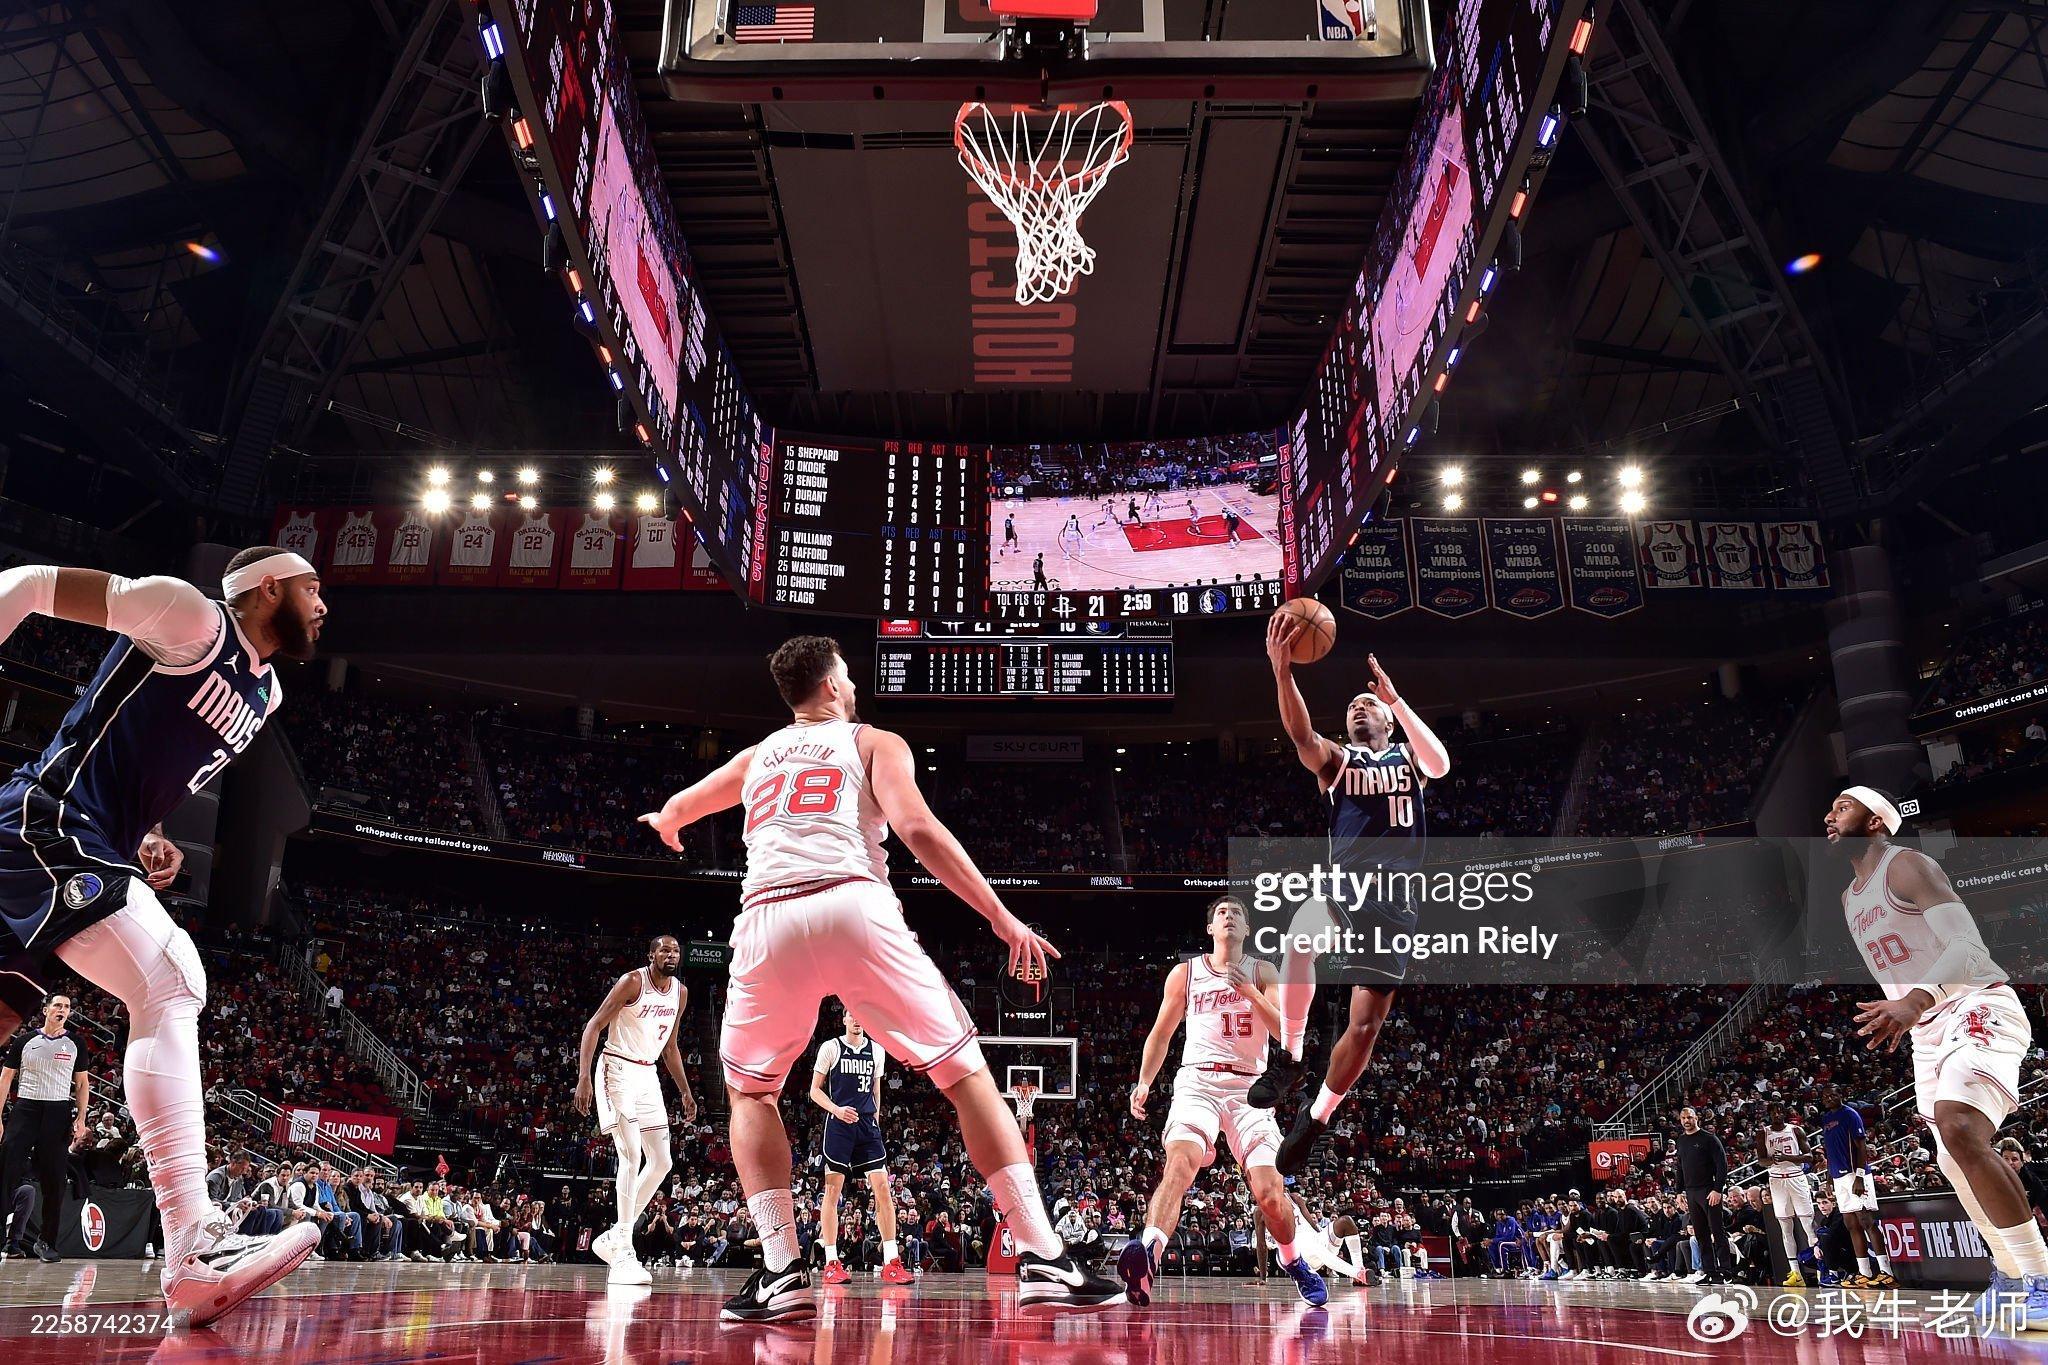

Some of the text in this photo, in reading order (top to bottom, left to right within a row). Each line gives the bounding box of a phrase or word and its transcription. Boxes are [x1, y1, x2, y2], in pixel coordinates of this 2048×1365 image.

[1326, 27, 1348, 40] NBA
[884, 442, 968, 456] PTS REB AST FLS
[787, 446, 966, 469] 15 SHEPPARD 0 0 0 0
[784, 460, 794, 470] 20
[797, 461, 826, 474] OKOGIE
[889, 468, 895, 479] 5
[937, 471, 941, 482] 1
[961, 472, 964, 483] 1
[784, 474, 964, 497] 28 SENGUN 0 2 2 1
[786, 488, 790, 498] 7
[796, 489, 827, 502] DURANT
[911, 498, 917, 509] 4
[935, 499, 941, 510] 2
[960, 500, 964, 511] 1
[752, 442, 770, 582] ROCKETS
[784, 502, 790, 513] 17
[795, 503, 821, 516] EASON
[888, 511, 893, 522] 7
[936, 514, 940, 524] 1
[960, 515, 963, 525] 1
[1278, 444, 1297, 584] ROCKETS
[577, 528, 614, 538] OLAJUWON
[882, 526, 966, 540] PTS REB AST FLS
[285, 535, 306, 548] 44
[347, 534, 366, 548] 45
[463, 535, 483, 548] 24
[523, 535, 542, 549] 22
[584, 536, 605, 550] 34
[781, 531, 789, 542] 10
[793, 532, 832, 546] WILLIAMS
[910, 541, 916, 552] 0
[934, 542, 940, 553] 0
[958, 543, 964, 554] 0
[1359, 545, 1386, 554] 1997
[1434, 544, 1462, 554] 1998
[1508, 545, 1537, 554] 1999
[1586, 544, 1615, 553] 2000
[780, 546, 963, 568] 21 GAFFORD 2 4 1 1
[1356, 557, 1392, 567] WNBA
[1431, 557, 1467, 566] WNBA
[1505, 557, 1542, 567] WNBA
[1584, 556, 1620, 565] WNBA
[778, 560, 963, 583] 25 WASHINGTON 2 2 0 1
[1344, 569, 1405, 581] Champions
[1420, 568, 1481, 580] Champions
[1494, 569, 1555, 581] Champions
[1573, 568, 1635, 579] Champions
[776, 575, 963, 598] 00 CHRISTIE 0 0 0 0
[1231, 582, 1280, 597] TOL FLS CC
[776, 590, 786, 601] 32
[789, 590, 814, 604] FLAGG
[908, 600, 914, 611] 2
[934, 601, 937, 612] 1
[957, 601, 963, 613] 0
[997, 594, 1045, 606] TOL FLS CC
[1088, 596, 1104, 616] 21
[1123, 594, 1152, 610] 2:59
[1172, 592, 1188, 613] 18
[1236, 595, 1277, 609] 6 2 1
[1001, 606, 1041, 618] 7 4 1
[1955, 692, 2032, 718] Orthopedic care
[745, 766, 848, 833] 28
[1388, 796, 1414, 827] 10
[1902, 802, 1917, 813] CC
[355, 824, 491, 852] Orthopedic care tailored to you.
[1465, 859, 1513, 873] Orthopedic
[1514, 858, 1533, 866] care
[1535, 852, 1570, 864] tailored
[1572, 852, 1582, 860] to
[1013, 877, 1040, 886] to you.
[1184, 879, 1229, 887] Orthopedic
[1957, 866, 2042, 887] Orthopedic care
[689, 948, 722, 958] ALSCO
[1865, 933, 1912, 971] 20
[637, 1004, 676, 1019] H-Town
[1221, 1012, 1252, 1038] 15
[658, 1025, 668, 1041] 7
[857, 1075, 871, 1093] 32
[323, 1122, 381, 1142] TUNDRA
[1784, 1146, 1792, 1154] 2
[1921, 1222, 1955, 1257] THE
